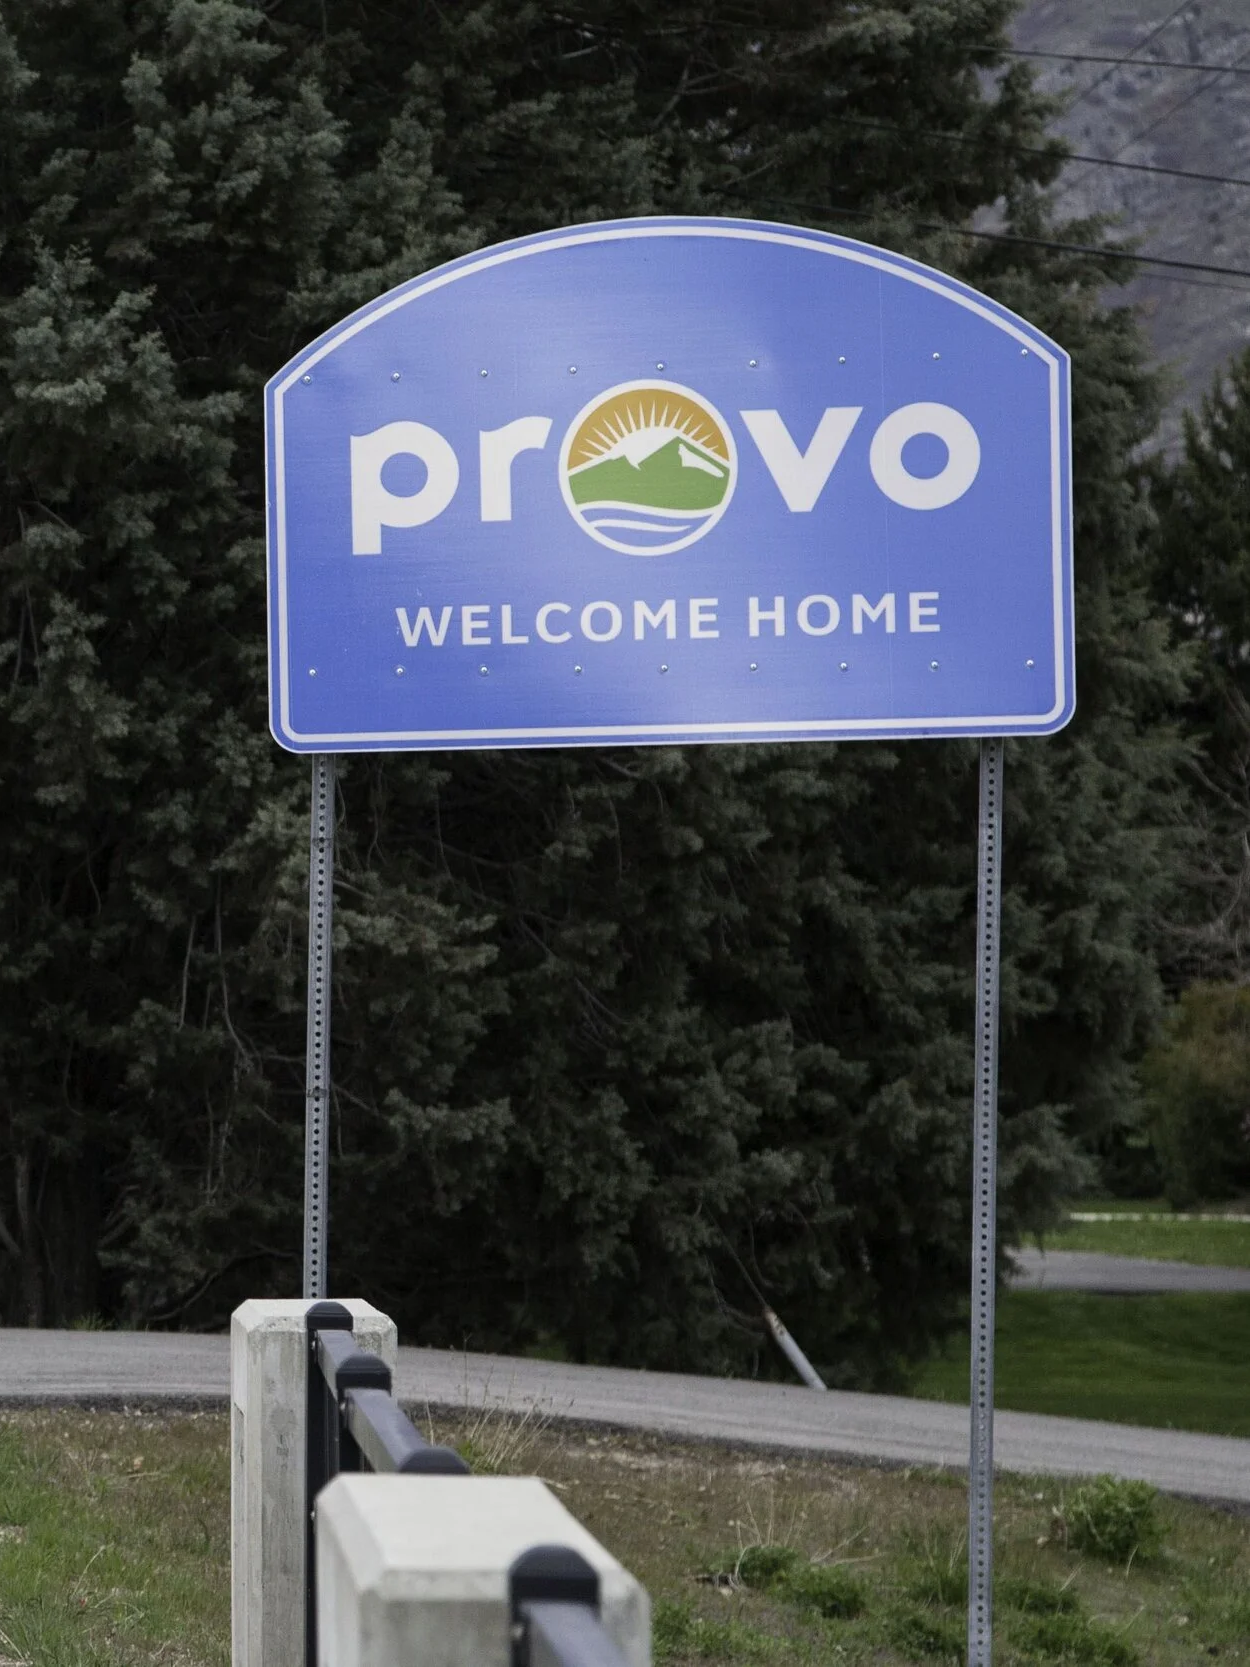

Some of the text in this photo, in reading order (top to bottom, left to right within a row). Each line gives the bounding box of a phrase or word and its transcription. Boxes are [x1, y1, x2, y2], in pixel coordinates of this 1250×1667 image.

[350, 379, 980, 557] provo
[395, 592, 941, 647] WELCOME HOME
